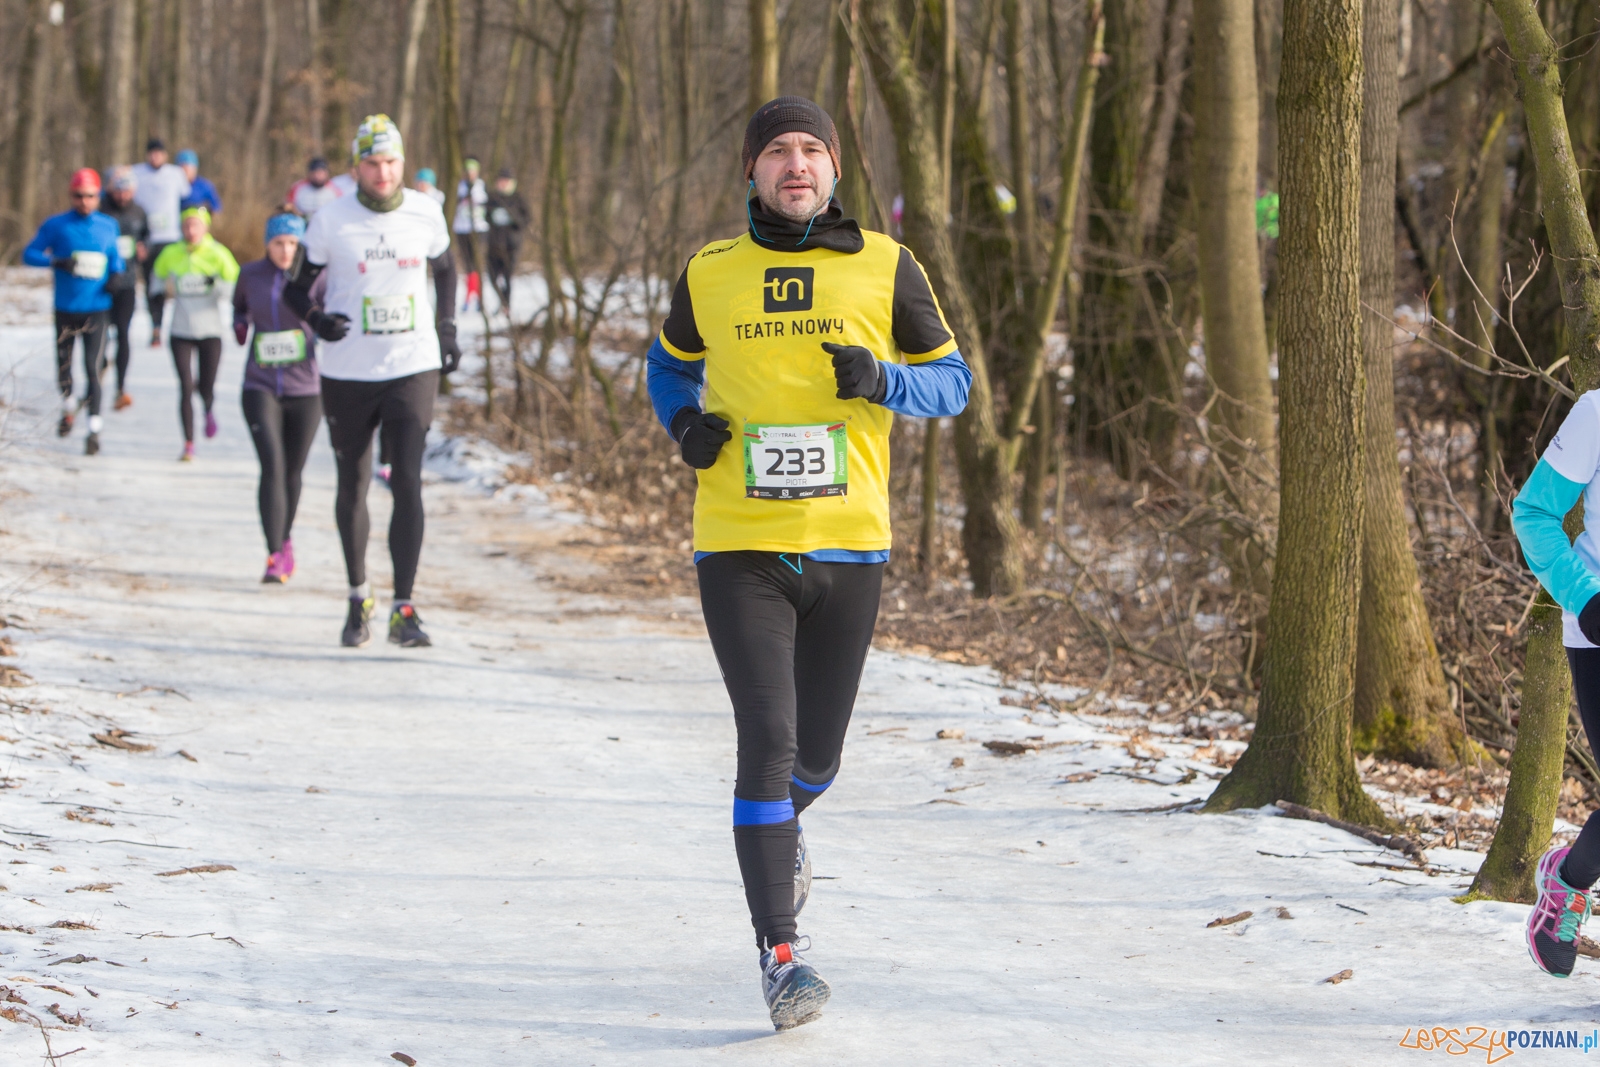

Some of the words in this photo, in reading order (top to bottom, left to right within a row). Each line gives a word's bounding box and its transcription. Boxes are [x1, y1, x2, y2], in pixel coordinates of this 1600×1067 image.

[365, 249, 396, 260] RUN
[371, 306, 409, 323] 1347
[734, 321, 785, 341] TEATR
[792, 318, 844, 336] NOWY
[764, 447, 826, 476] 233
[785, 478, 808, 486] PIOTR
